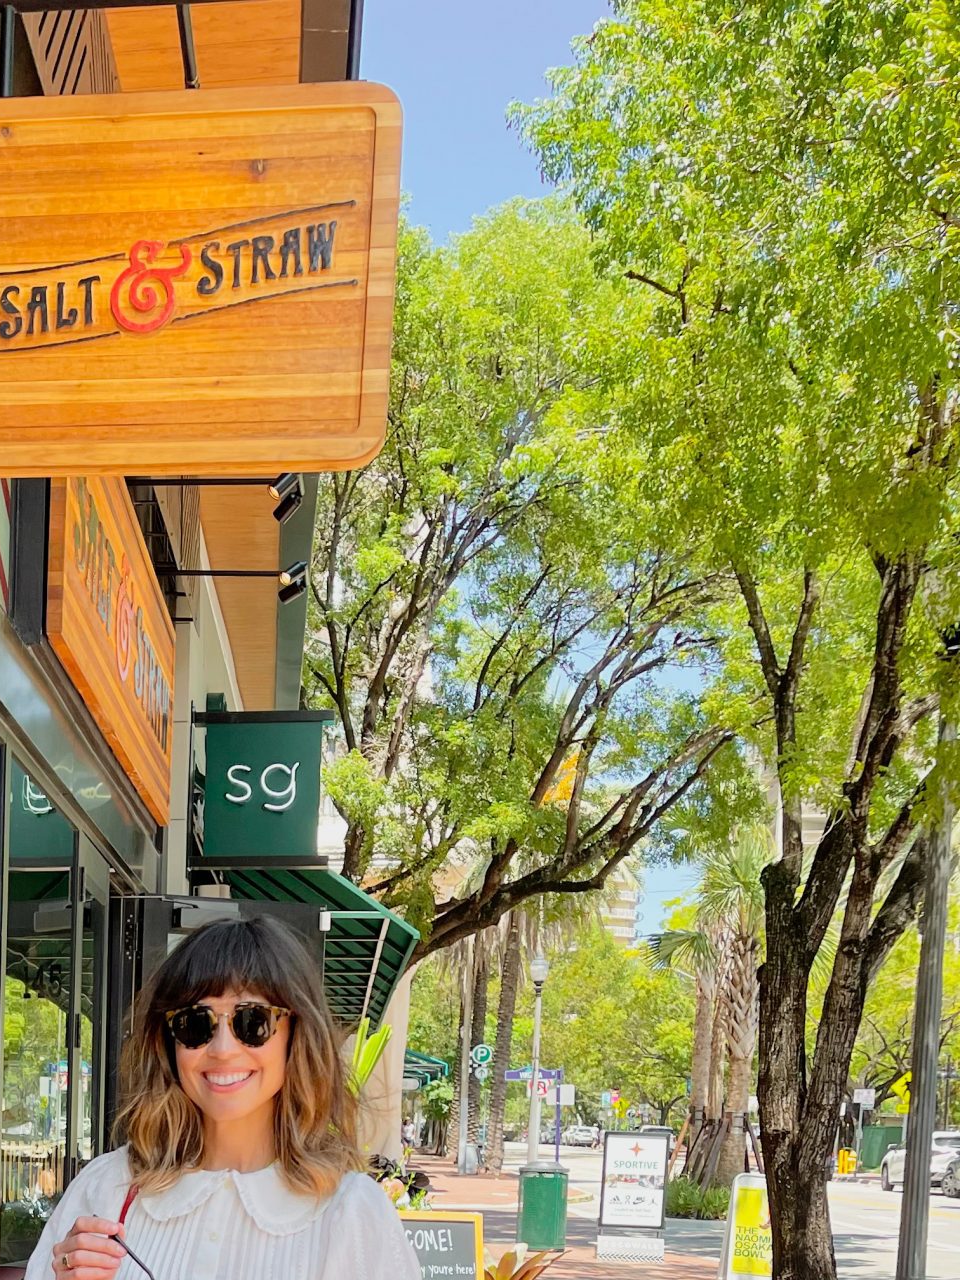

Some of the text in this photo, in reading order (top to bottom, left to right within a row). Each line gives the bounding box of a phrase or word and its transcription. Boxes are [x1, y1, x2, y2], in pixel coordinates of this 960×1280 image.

[110, 239, 192, 332] &
[197, 220, 338, 295] STRAW
[225, 761, 300, 812] sg
[613, 1160, 659, 1170] SPORTIVE
[736, 1225, 759, 1235] THE
[735, 1234, 771, 1244] NAOMI
[734, 1248, 767, 1259] BOWL
